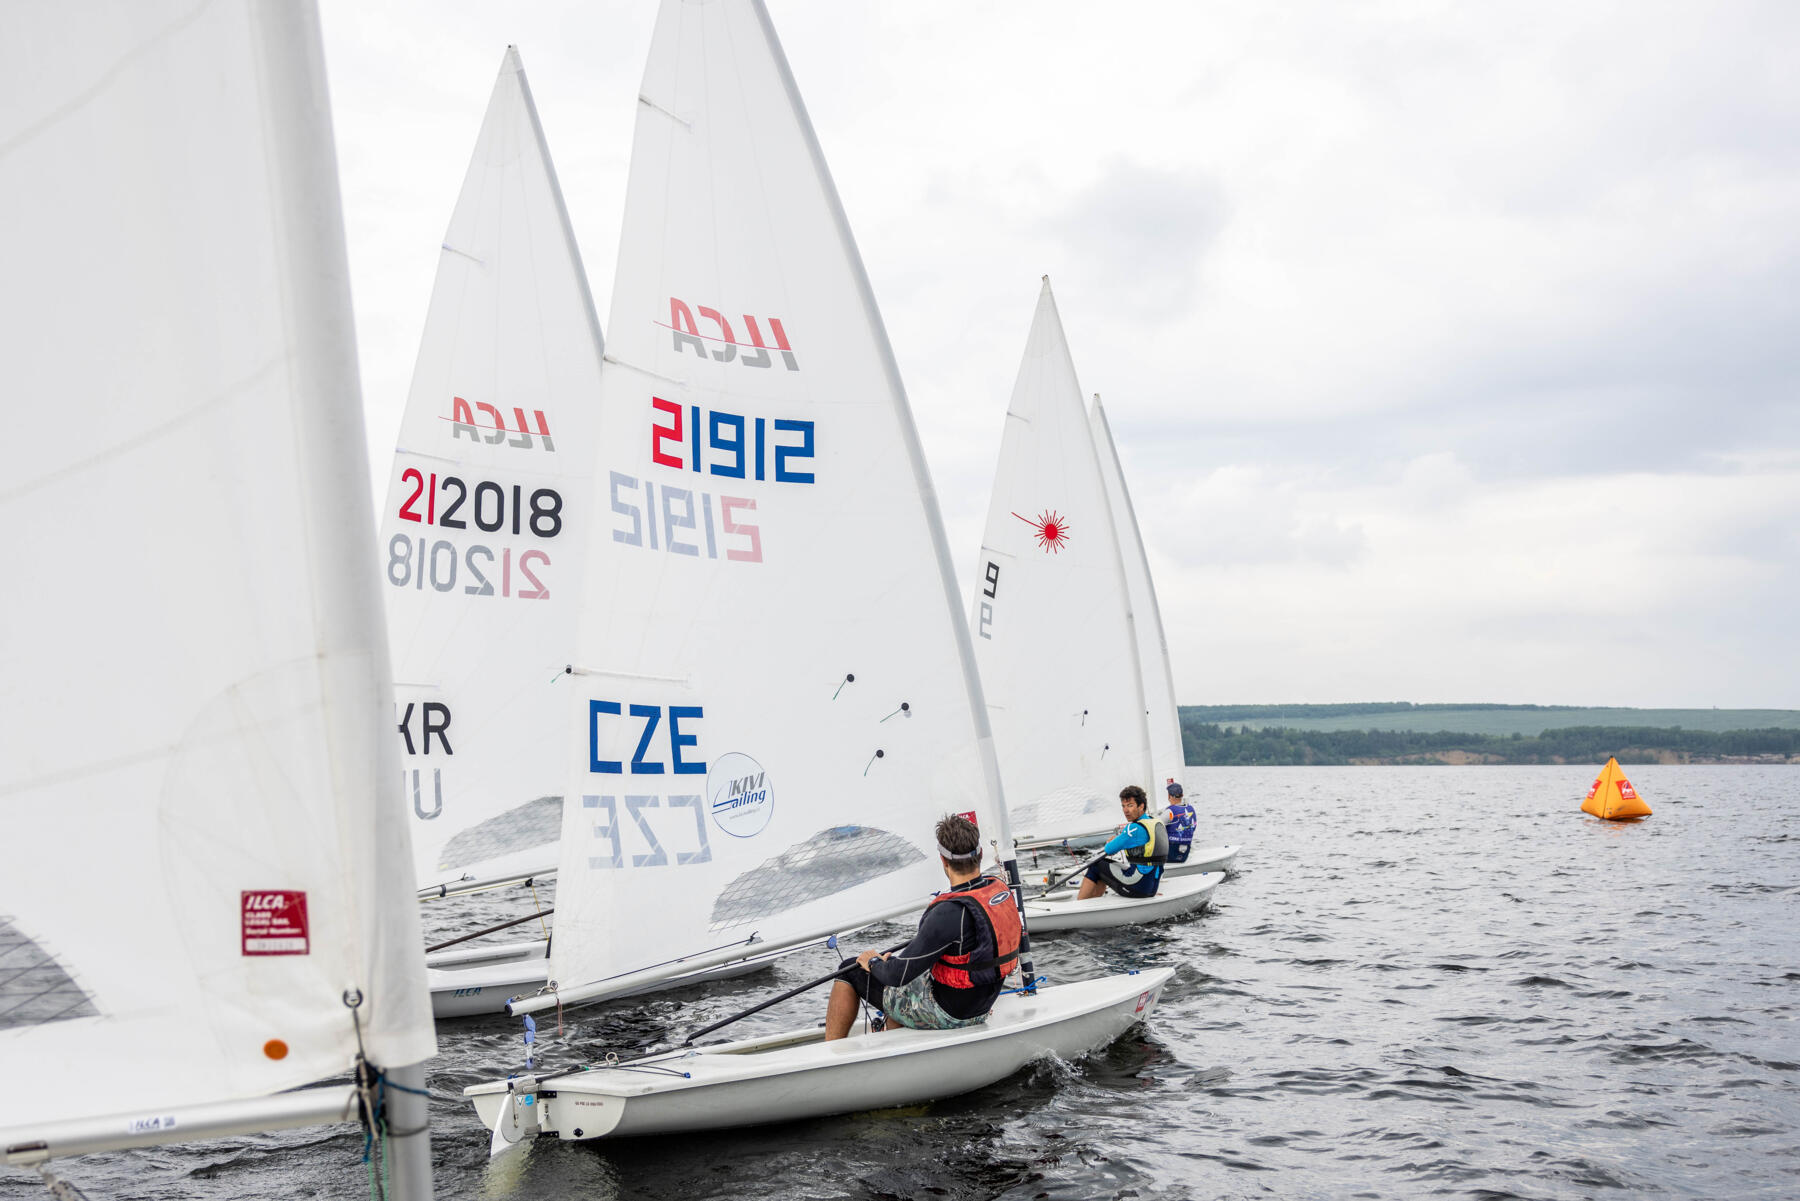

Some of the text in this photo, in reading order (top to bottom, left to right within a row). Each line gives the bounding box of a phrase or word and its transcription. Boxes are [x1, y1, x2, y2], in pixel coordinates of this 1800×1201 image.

[652, 395, 815, 485] 21912
[398, 467, 563, 538] 212018
[983, 560, 1000, 599] 9
[589, 699, 707, 775] CZE
[731, 771, 765, 796] KIVI
[246, 895, 284, 909] ILCA
